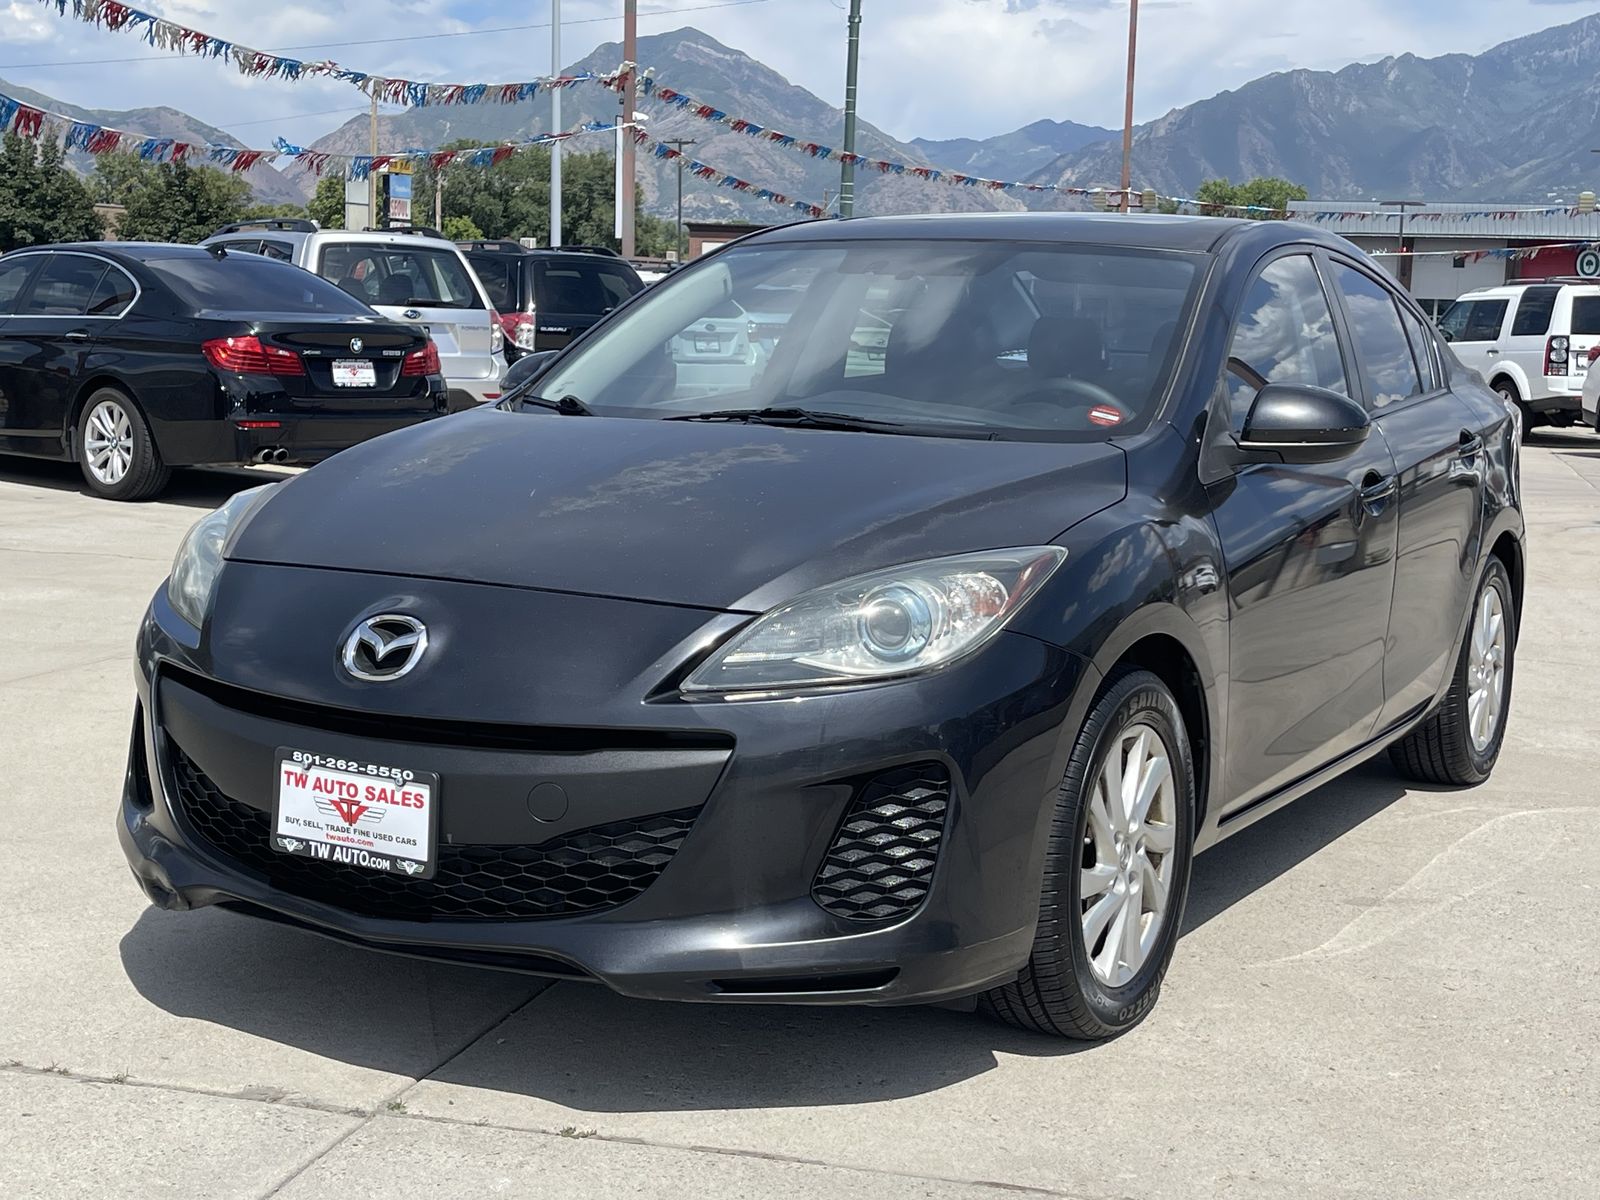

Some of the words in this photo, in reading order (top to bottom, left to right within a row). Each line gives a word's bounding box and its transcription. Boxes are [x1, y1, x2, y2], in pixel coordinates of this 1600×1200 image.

[292, 751, 414, 781] 801-262-5550
[284, 770, 309, 789] TW
[312, 777, 359, 798] AUTO
[364, 786, 425, 809] SALES
[285, 816, 301, 827] BUY,
[303, 819, 324, 831] SELL,
[325, 823, 351, 834] TRADE
[353, 827, 371, 838] FINE
[373, 831, 393, 842] USED
[395, 836, 417, 846] CARS
[325, 833, 375, 848] twauto.com
[309, 841, 330, 859] TW
[332, 846, 391, 871] AUTO.COM
